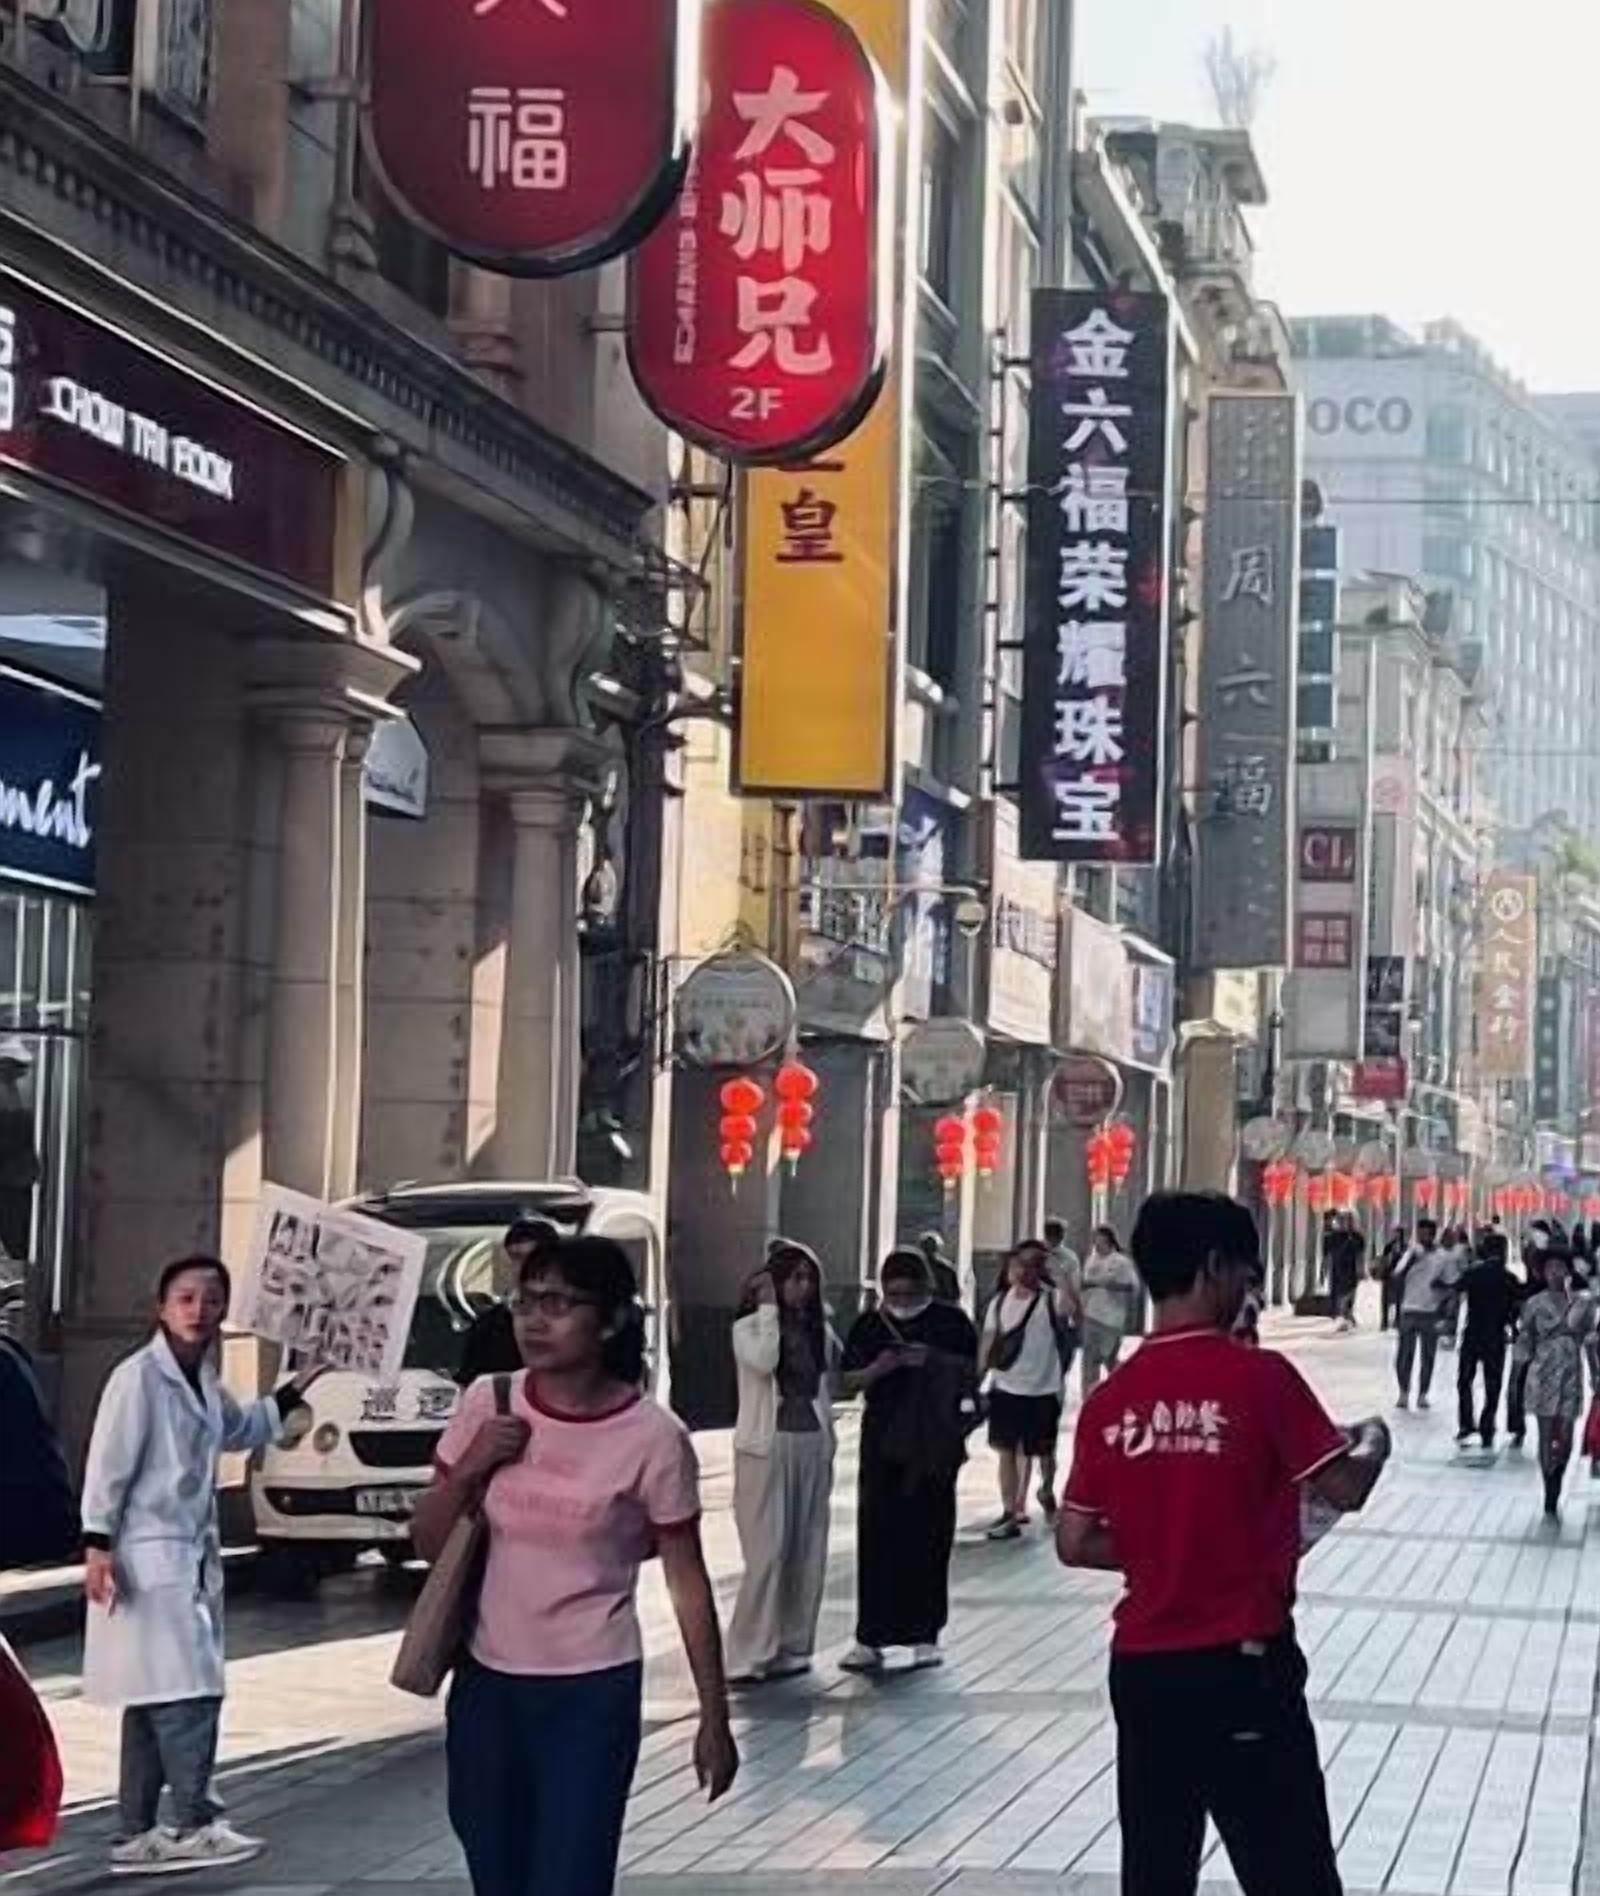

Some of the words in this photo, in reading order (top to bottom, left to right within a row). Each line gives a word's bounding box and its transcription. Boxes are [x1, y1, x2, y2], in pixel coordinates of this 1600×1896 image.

[718, 64, 836, 376] 大师兄
[729, 386, 785, 420] 2F
[1052, 308, 1135, 842] 金六福荣耀珠宝
